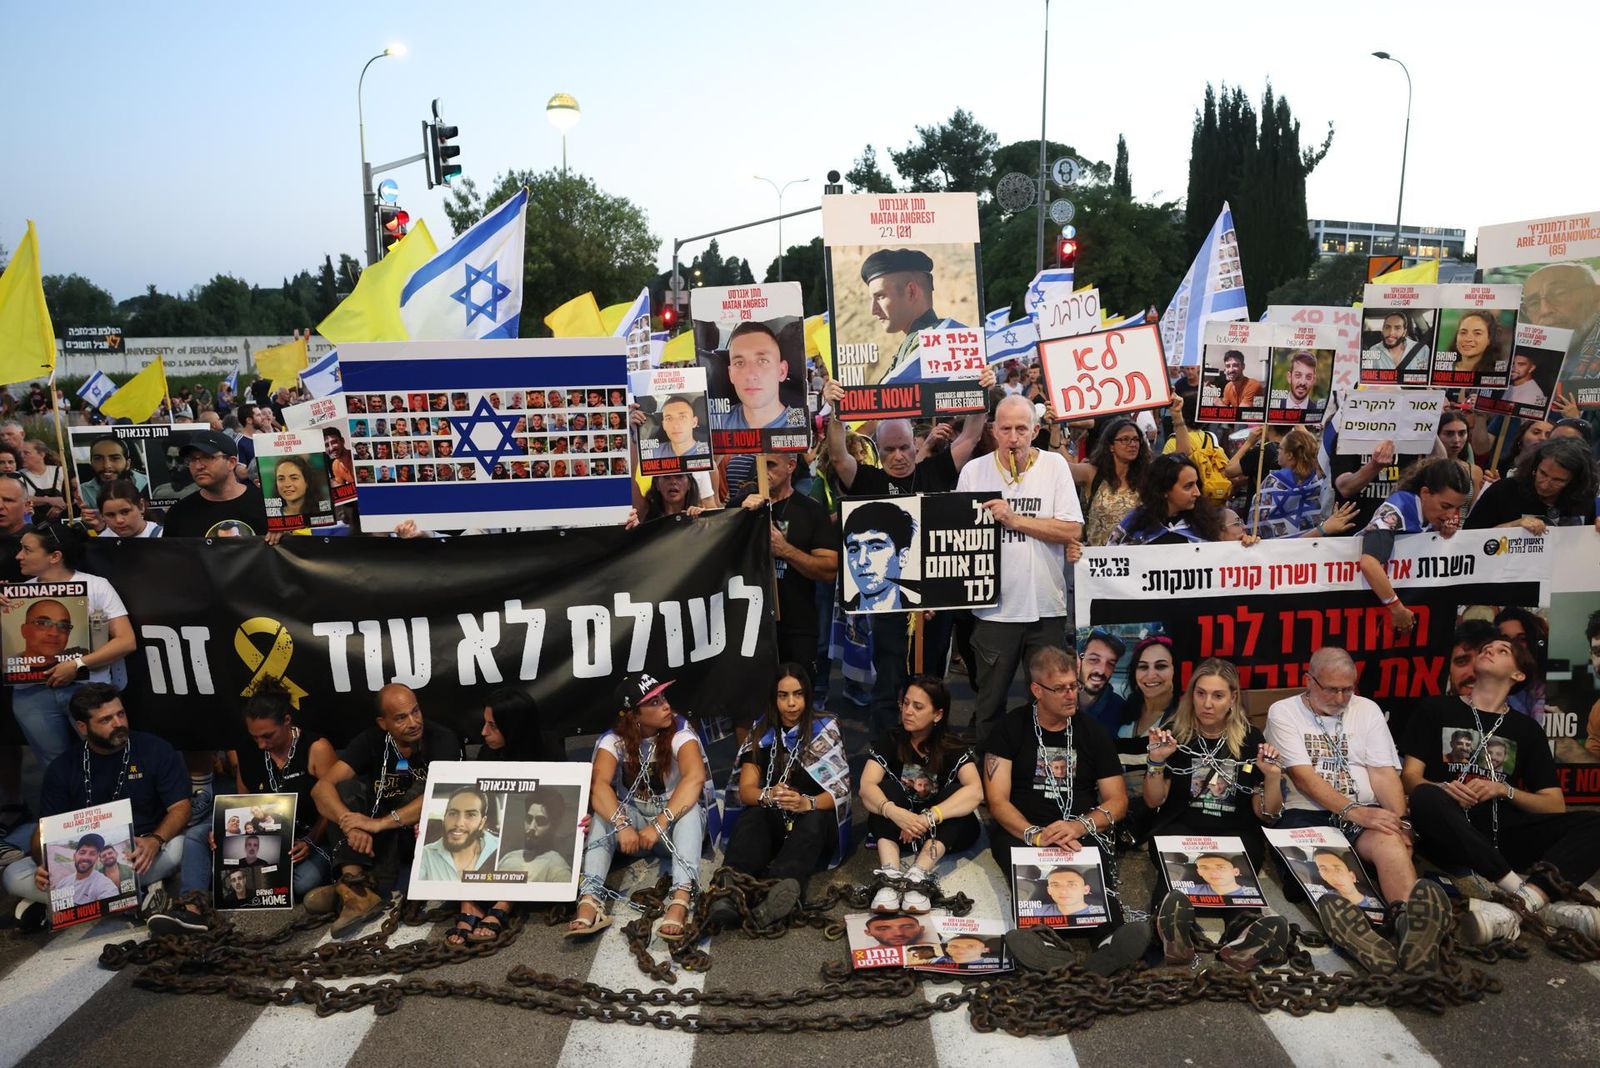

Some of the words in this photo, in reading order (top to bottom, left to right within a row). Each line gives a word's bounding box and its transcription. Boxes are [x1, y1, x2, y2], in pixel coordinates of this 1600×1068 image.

[879, 199, 909, 212] אנגרסט
[911, 198, 926, 211] מתן
[870, 212, 898, 225] MATAN
[900, 210, 936, 224] ANGREST
[1569, 217, 1592, 230] אריה
[1517, 235, 1536, 248] ARIE
[1538, 227, 1600, 246] ZALMANOWICZ
[1549, 243, 1567, 256] (85)
[727, 288, 749, 300] אנגרסט
[750, 287, 762, 299] מתן
[722, 299, 743, 310] MATAN
[743, 297, 769, 308] ANGREST
[740, 308, 752, 320] (21)
[946, 331, 978, 344] למה
[125, 346, 174, 356] UNIVERSITY
[178, 345, 187, 354] of
[190, 345, 238, 354] JERUSALEM
[837, 343, 879, 364] BRING
[1072, 331, 1125, 371] לא
[1361, 350, 1381, 360] BRING
[1436, 351, 1457, 361] BRING
[184, 360, 206, 368] SAFRA
[208, 358, 240, 368] CAMPUS
[837, 367, 866, 386] HIM
[840, 389, 878, 411] HOME
[881, 384, 921, 409] NOW!
[1061, 371, 1152, 412] תרצח
[708, 398, 731, 414] RING
[936, 399, 962, 409] FAMILIES
[963, 397, 984, 407] FORUM
[1349, 398, 1396, 412] להקריב
[1409, 400, 1438, 411] אסור
[1344, 420, 1397, 432] החטופים
[1414, 422, 1433, 432] את
[115, 428, 151, 440] צנגאוקר
[153, 428, 170, 438] מתן
[734, 430, 762, 447] NOW!
[640, 439, 660, 450] BRING
[642, 459, 661, 472] HOME
[662, 457, 681, 470] NOW!
[971, 499, 995, 526] אל
[928, 527, 996, 554] תשאירו
[1524, 537, 1545, 547] ראשון
[925, 555, 971, 579] אותם
[970, 554, 996, 577] גם
[1089, 558, 1107, 568] עוז
[1112, 557, 1130, 567] ניר
[1416, 553, 1476, 584] השבות
[1089, 568, 1130, 578] 7.10.23
[1219, 565, 1263, 591] קוניו
[1269, 562, 1317, 591] ושרון
[1324, 565, 1362, 588] יהוד
[1142, 568, 1214, 595] זועקות:
[3, 583, 84, 598] KIDNAPPED
[963, 576, 996, 603] לבד
[567, 575, 764, 679] לעולם
[1198, 605, 1265, 658] לנו
[456, 598, 546, 686] לא
[7, 656, 46, 665] BRING
[141, 624, 216, 695] זה
[313, 616, 432, 693] עוד
[7, 665, 31, 673] HIM
[1374, 655, 1444, 698] את
[1543, 712, 1578, 738] ING
[479, 781, 516, 796] צנגאוקר
[518, 781, 537, 796] מתן
[63, 821, 74, 830] GALI
[75, 819, 85, 827] AND
[1171, 880, 1195, 889] BRING
[50, 885, 76, 900] BRING
[256, 888, 274, 897] BRING
[262, 895, 288, 906] HOME
[1018, 900, 1042, 909] BRING
[52, 909, 78, 925] HOME
[78, 900, 102, 919] NOW!
[1018, 908, 1035, 917] HIM
[1019, 917, 1041, 926] HOME
[1043, 916, 1068, 925] NOW!
[866, 947, 899, 960] מתן
[857, 957, 900, 967] אנגרסט
